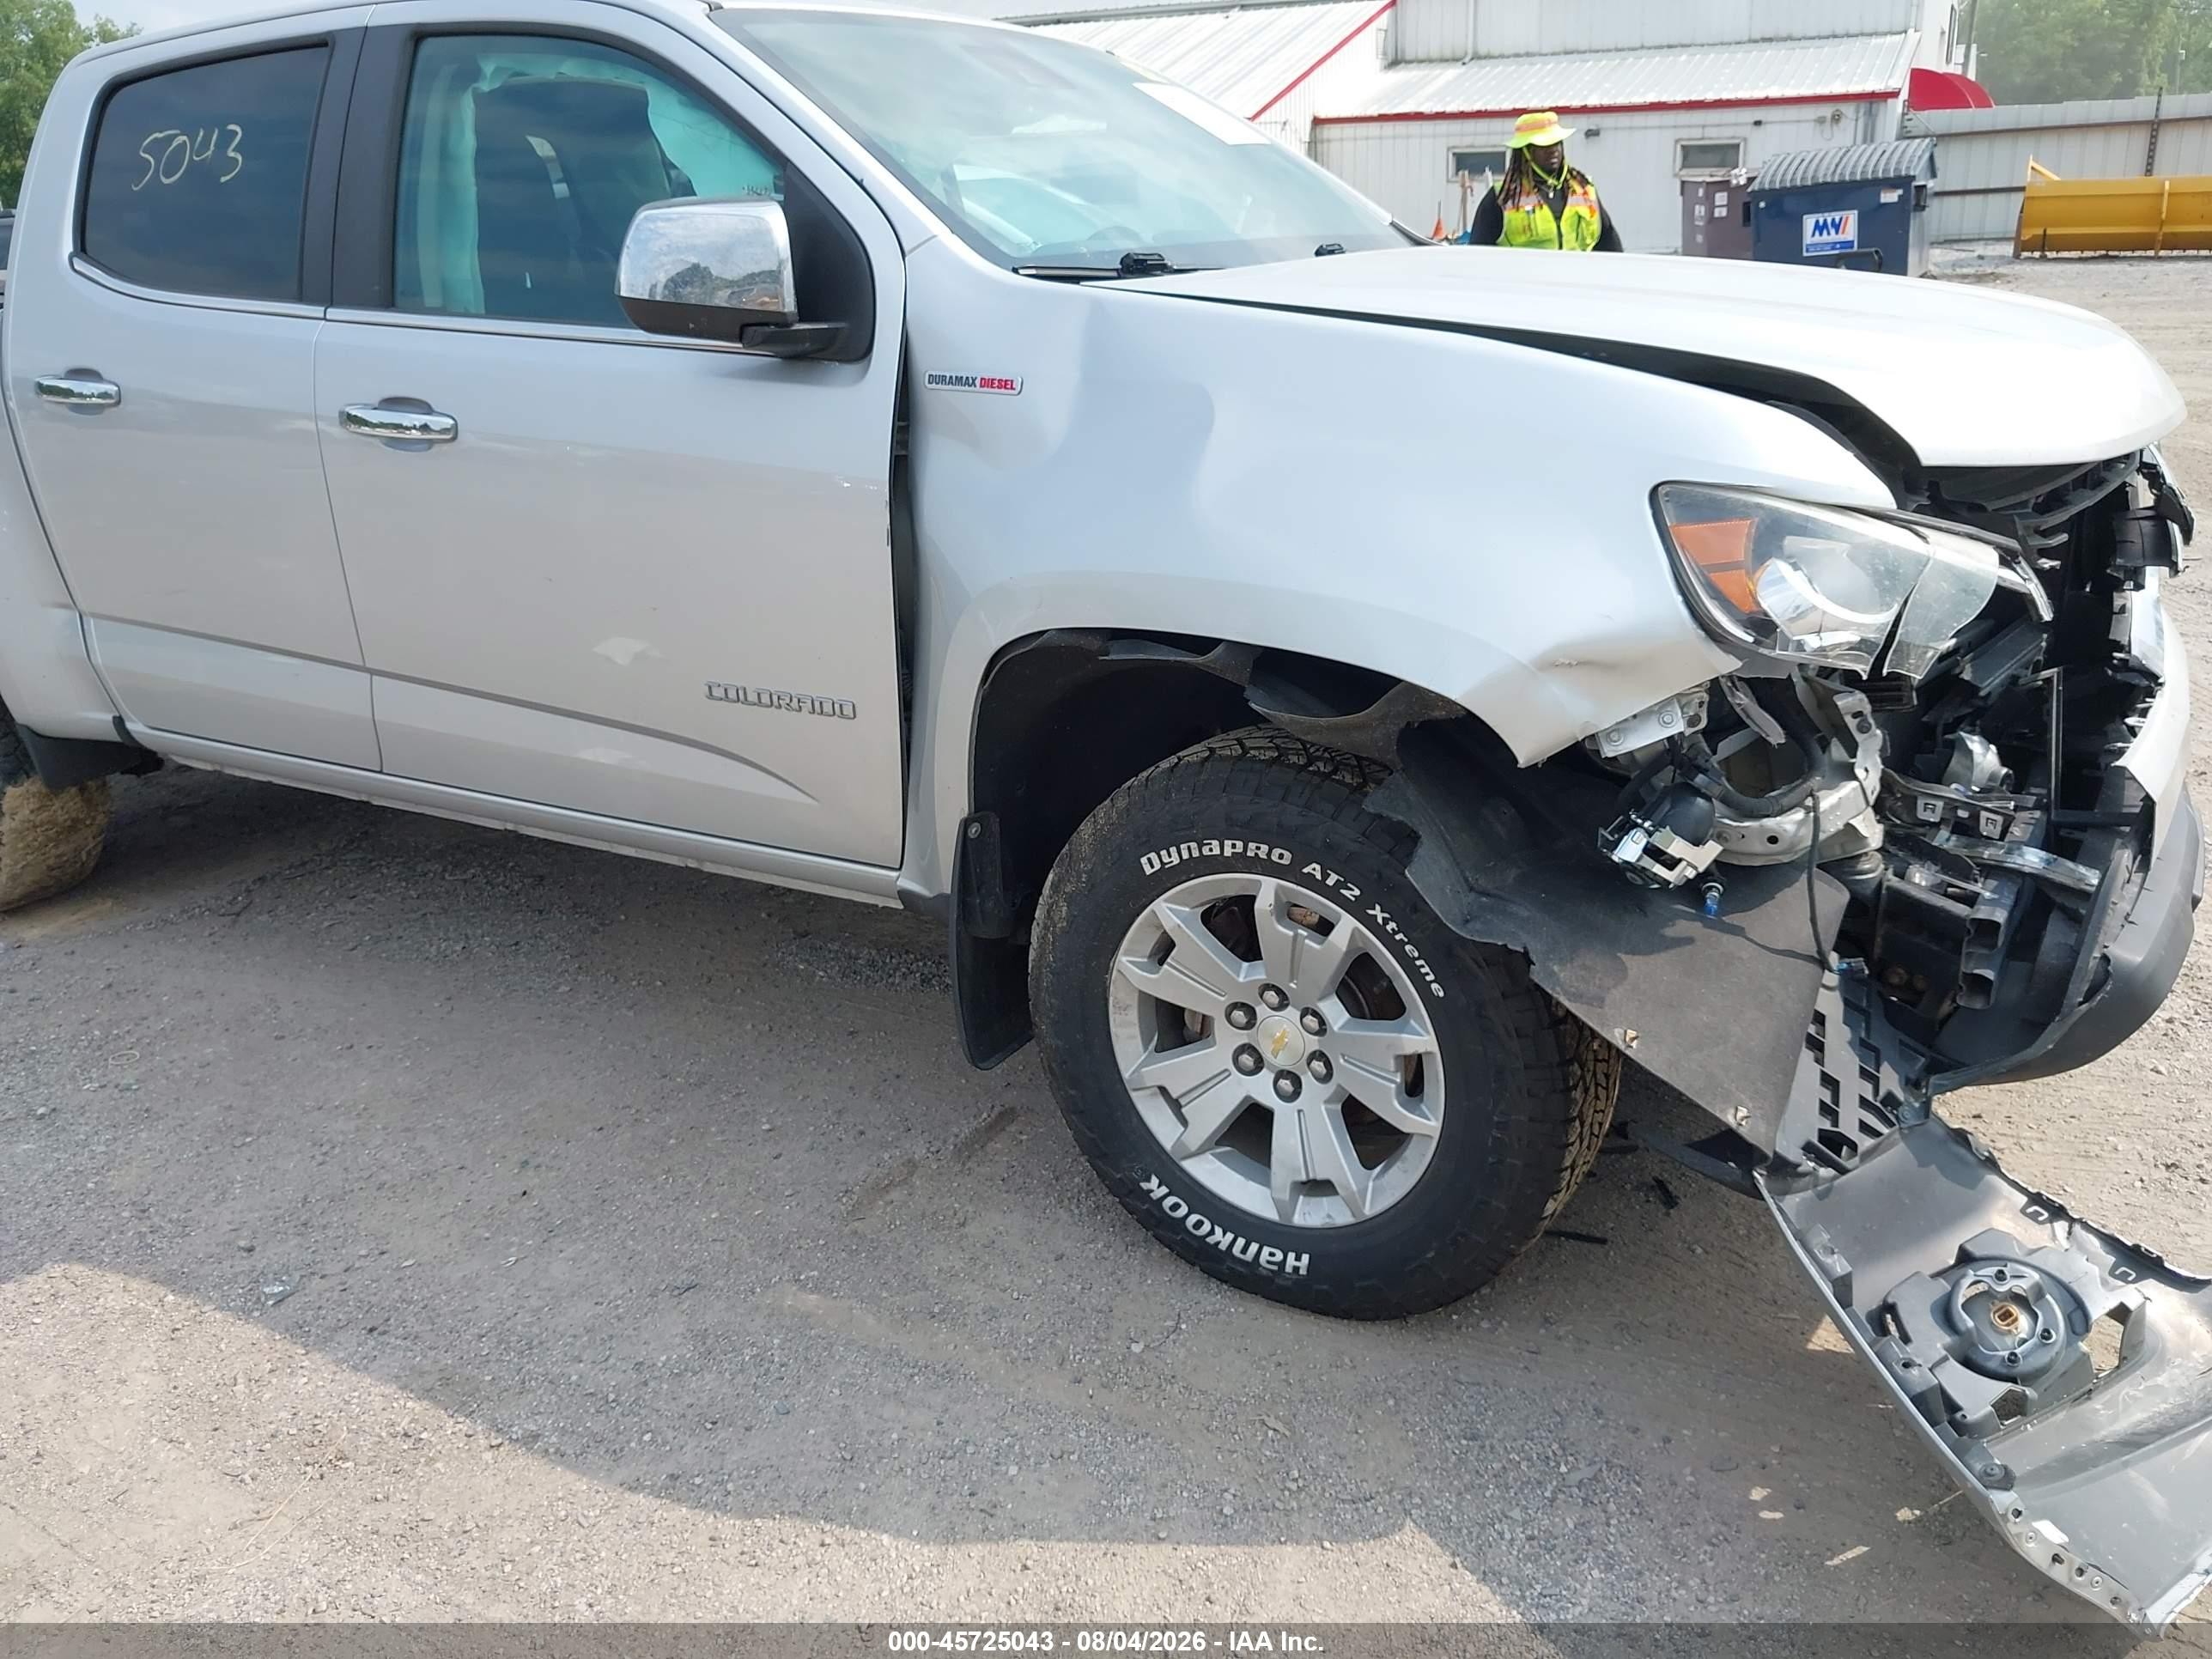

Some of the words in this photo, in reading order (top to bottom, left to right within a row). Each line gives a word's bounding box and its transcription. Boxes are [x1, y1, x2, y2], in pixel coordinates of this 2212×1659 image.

[131, 124, 242, 191] 5043
[927, 374, 977, 388] DURAMAX
[979, 377, 1016, 391] DIESEL
[704, 681, 857, 720] COLORADO
[1301, 862, 1361, 902] AT2
[1364, 902, 1446, 999] Xtreme
